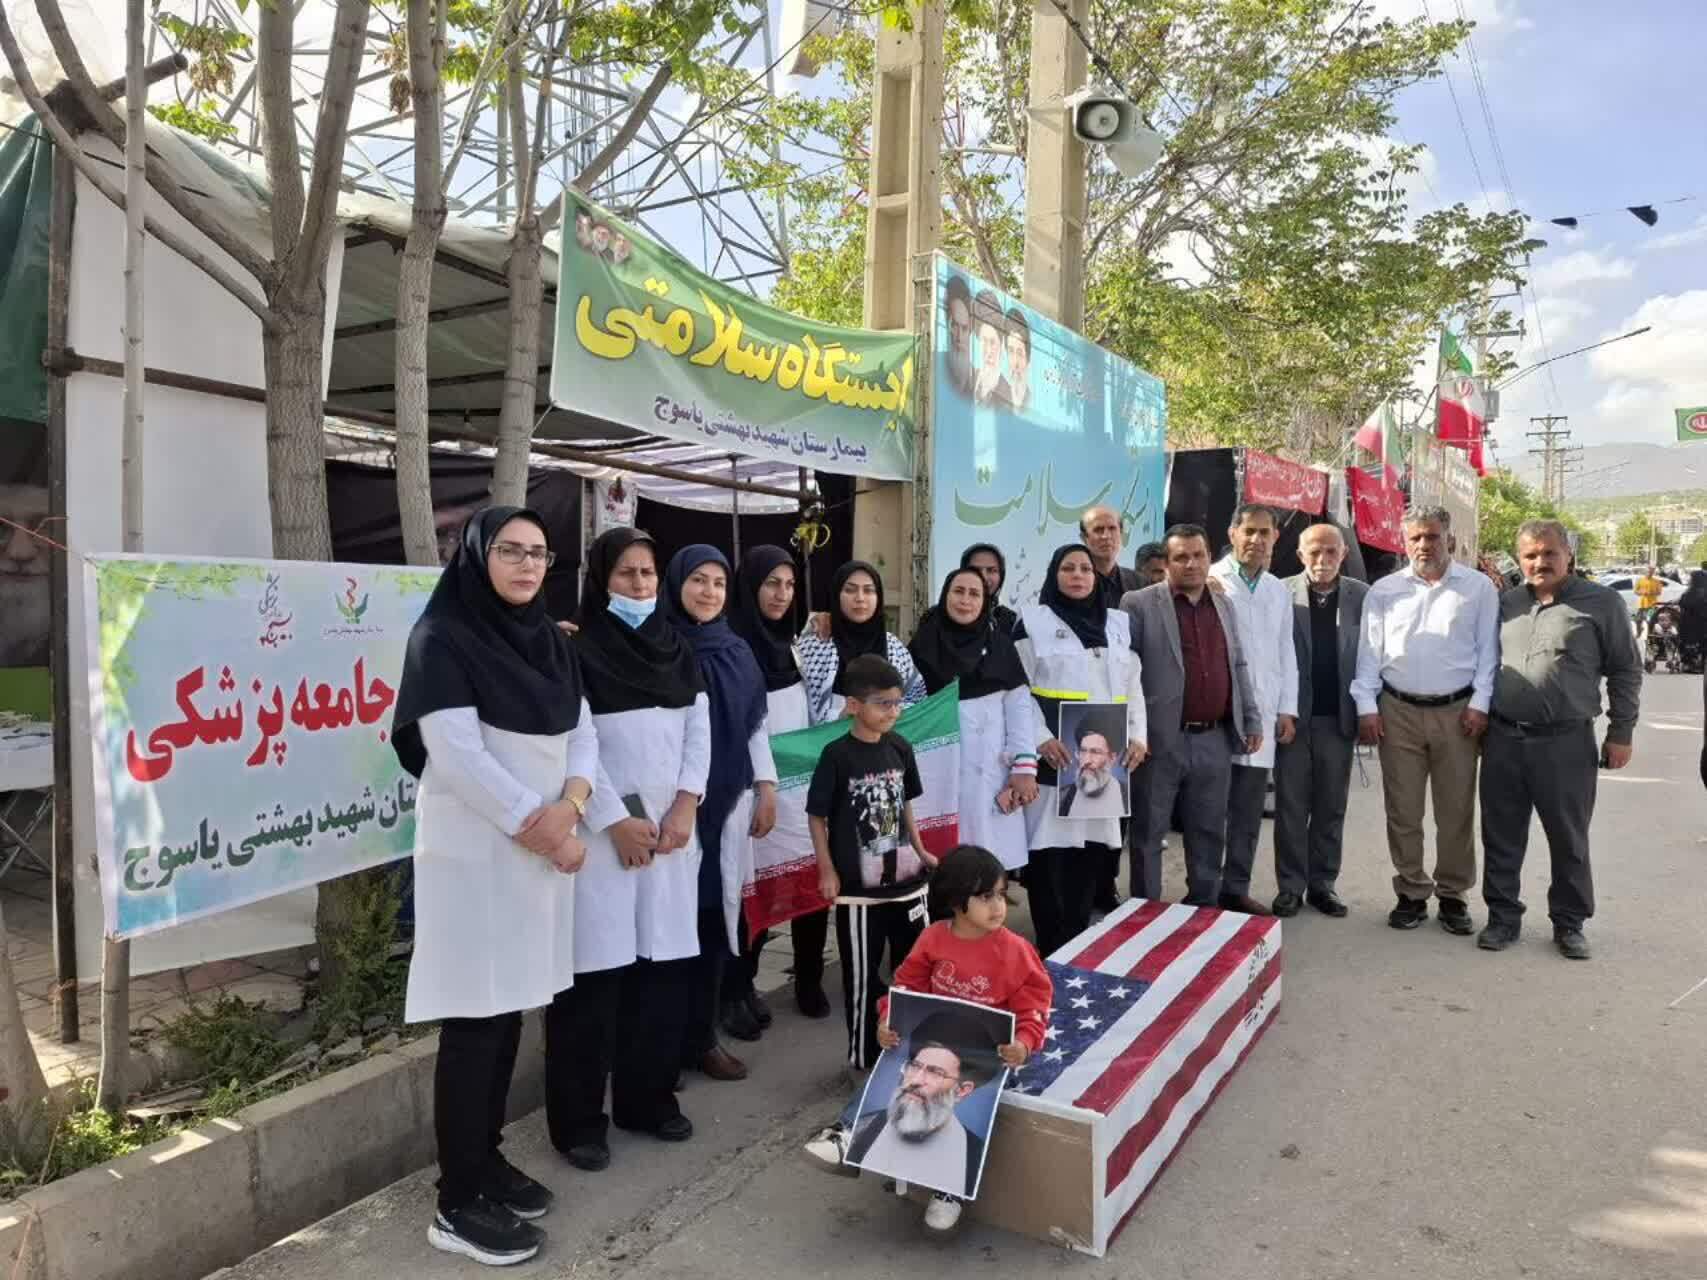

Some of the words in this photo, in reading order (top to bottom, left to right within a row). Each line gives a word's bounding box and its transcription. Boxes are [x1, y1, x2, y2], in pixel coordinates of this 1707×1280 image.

[575, 277, 778, 383] سلامتی
[654, 396, 705, 431] یاسوج
[777, 333, 912, 432] ایستگاه
[704, 412, 751, 443] بهشتی
[751, 424, 790, 449] شهید
[790, 430, 868, 463] بیمارستان
[126, 665, 288, 783] پزشکی
[290, 656, 396, 743] جامعه
[226, 803, 313, 868] بهشتی
[317, 786, 376, 838] شهید
[122, 818, 221, 892] یاسوج
